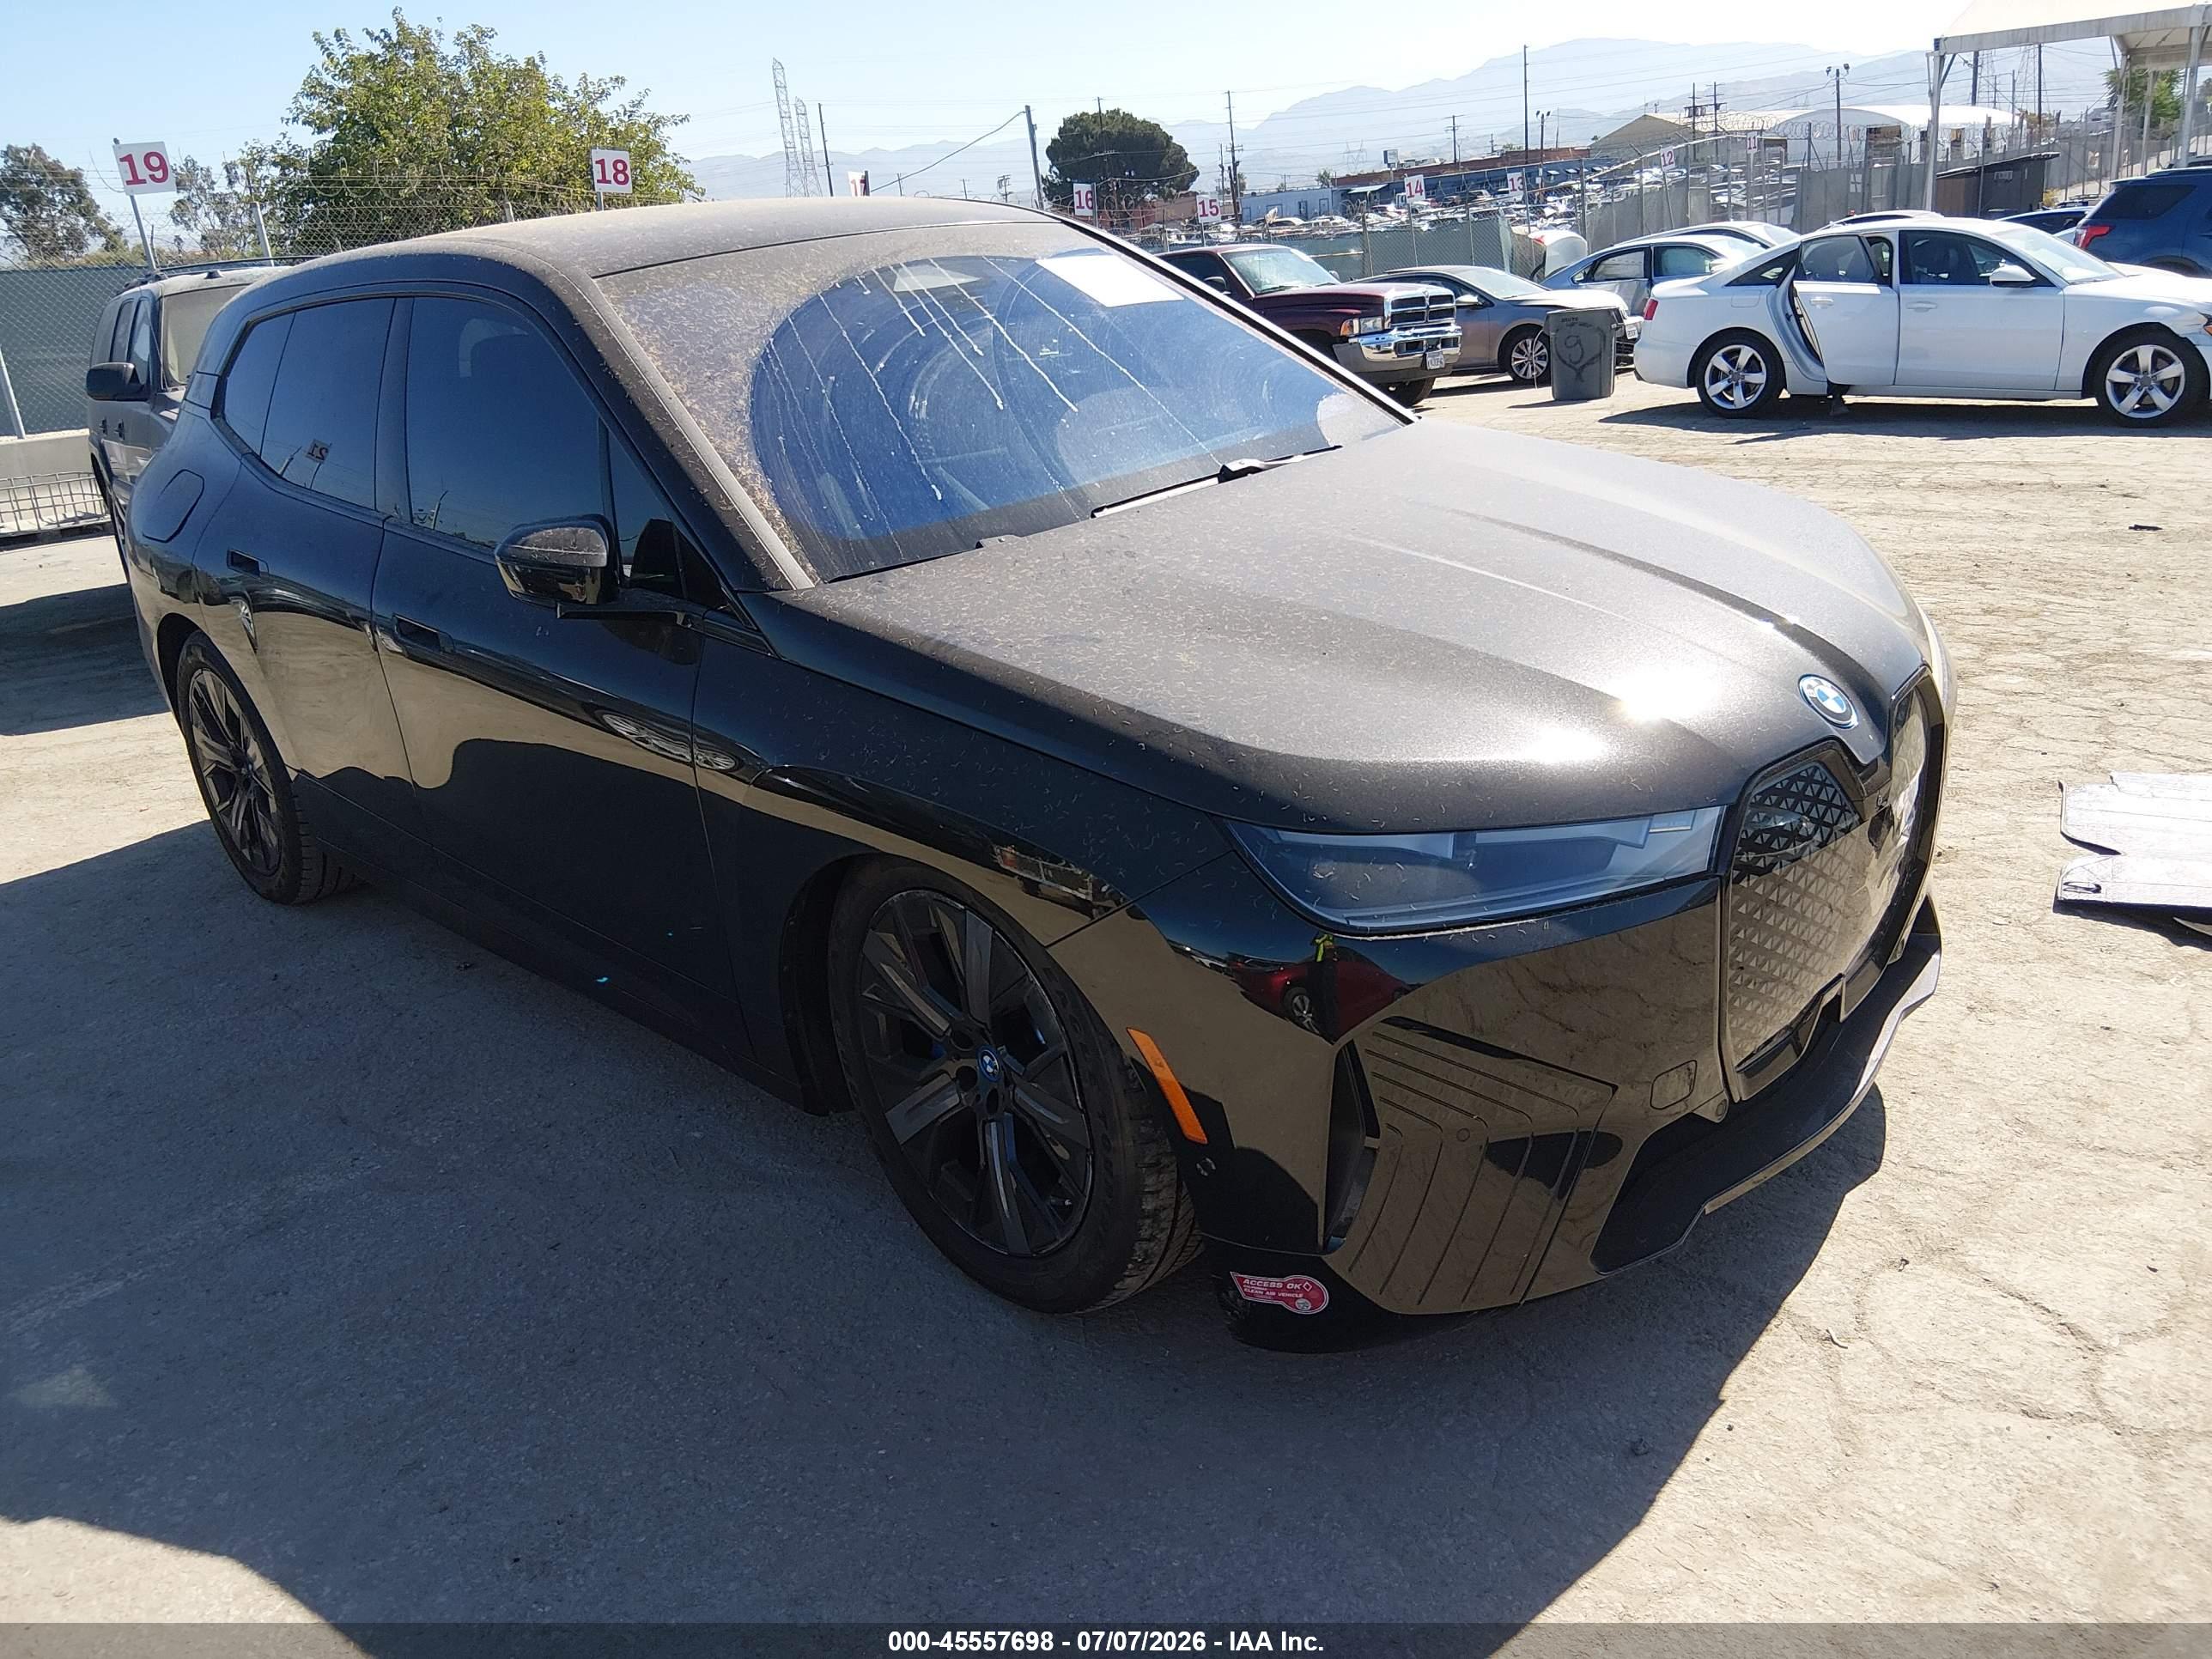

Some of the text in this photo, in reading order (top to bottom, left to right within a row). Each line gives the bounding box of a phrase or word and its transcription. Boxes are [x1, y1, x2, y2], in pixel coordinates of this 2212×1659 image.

[1747, 136, 1757, 150] 11
[119, 151, 169, 185] 19
[1661, 150, 1674, 167] 12
[595, 158, 629, 185] 18
[1407, 179, 1424, 199] 14
[1509, 176, 1524, 192] 13
[1075, 190, 1093, 210] 16
[1198, 198, 1219, 217] 15
[1243, 1279, 1284, 1289] ACCESS
